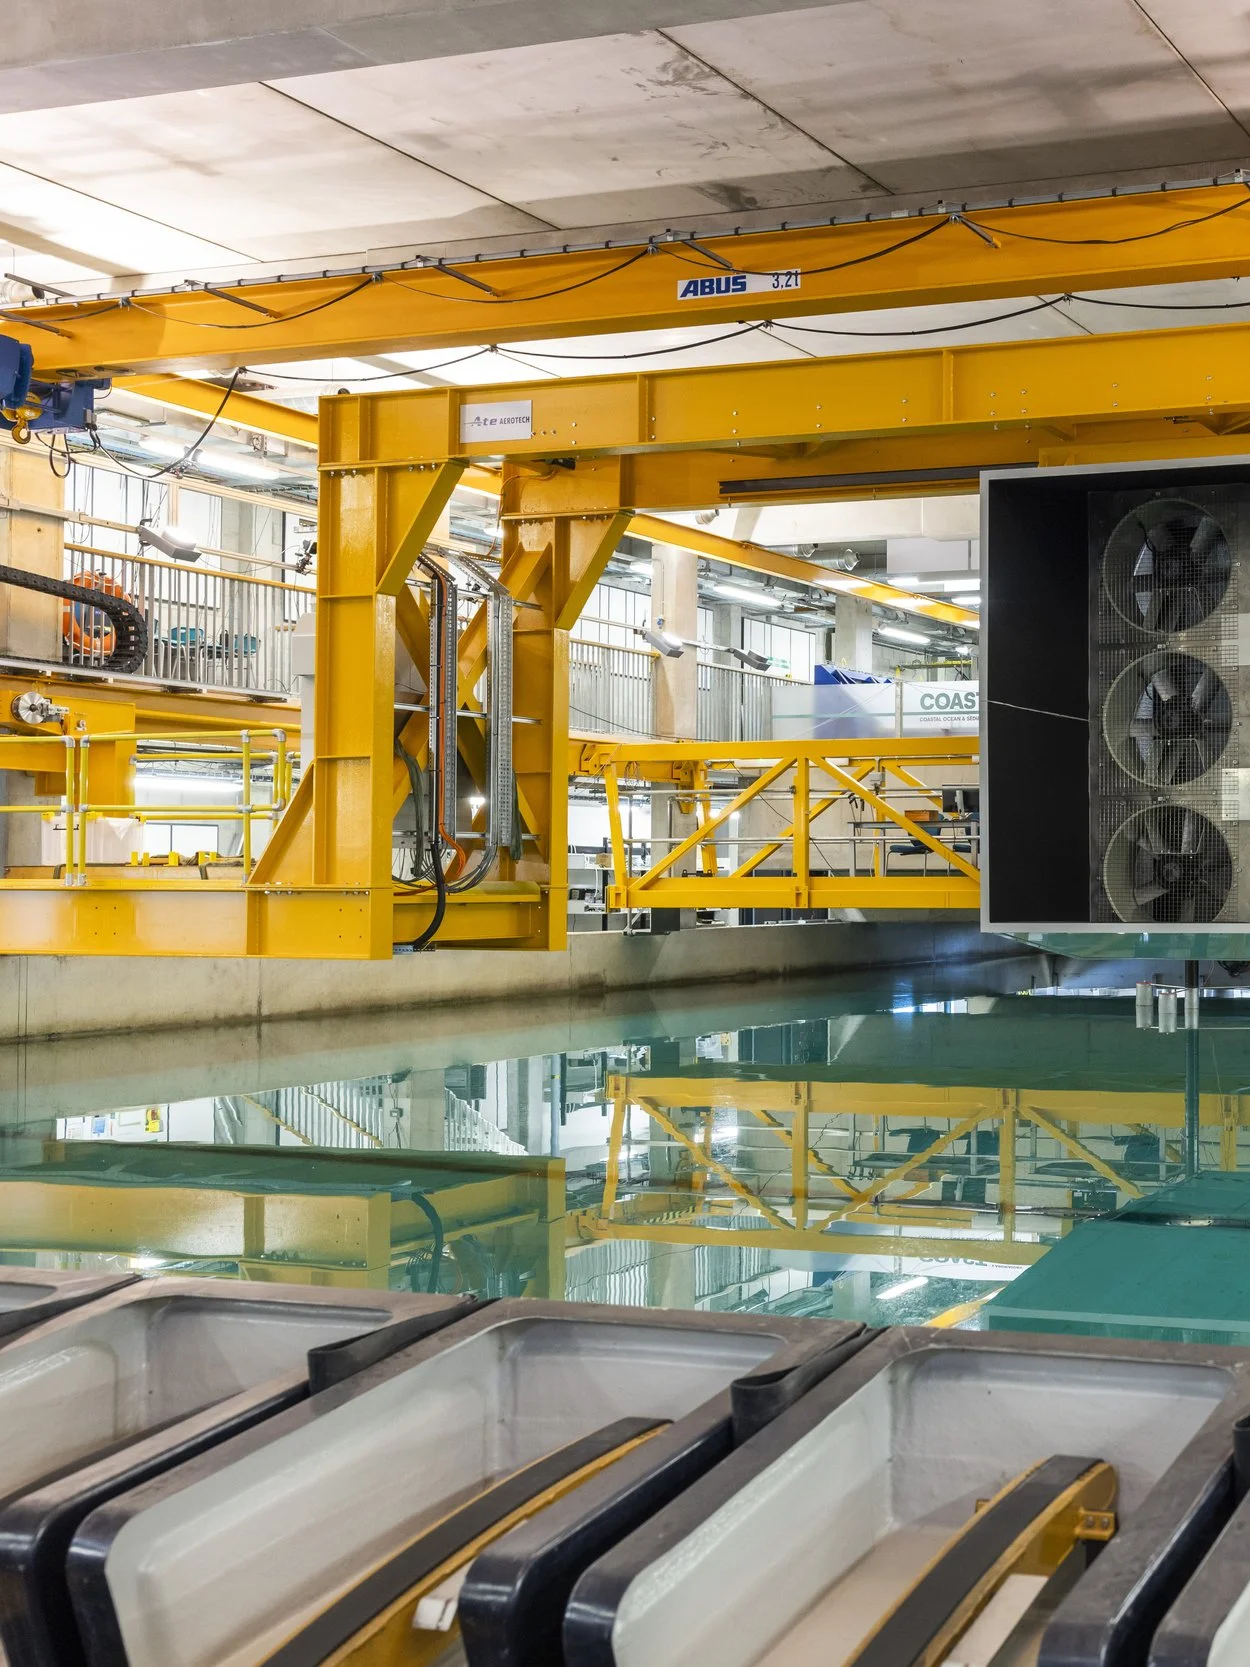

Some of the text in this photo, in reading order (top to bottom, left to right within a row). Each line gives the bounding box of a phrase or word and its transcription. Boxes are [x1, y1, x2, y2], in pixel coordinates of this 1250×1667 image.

[680, 275, 746, 297] ABUS
[499, 416, 530, 424] AEROTECH
[920, 691, 979, 710] COAS
